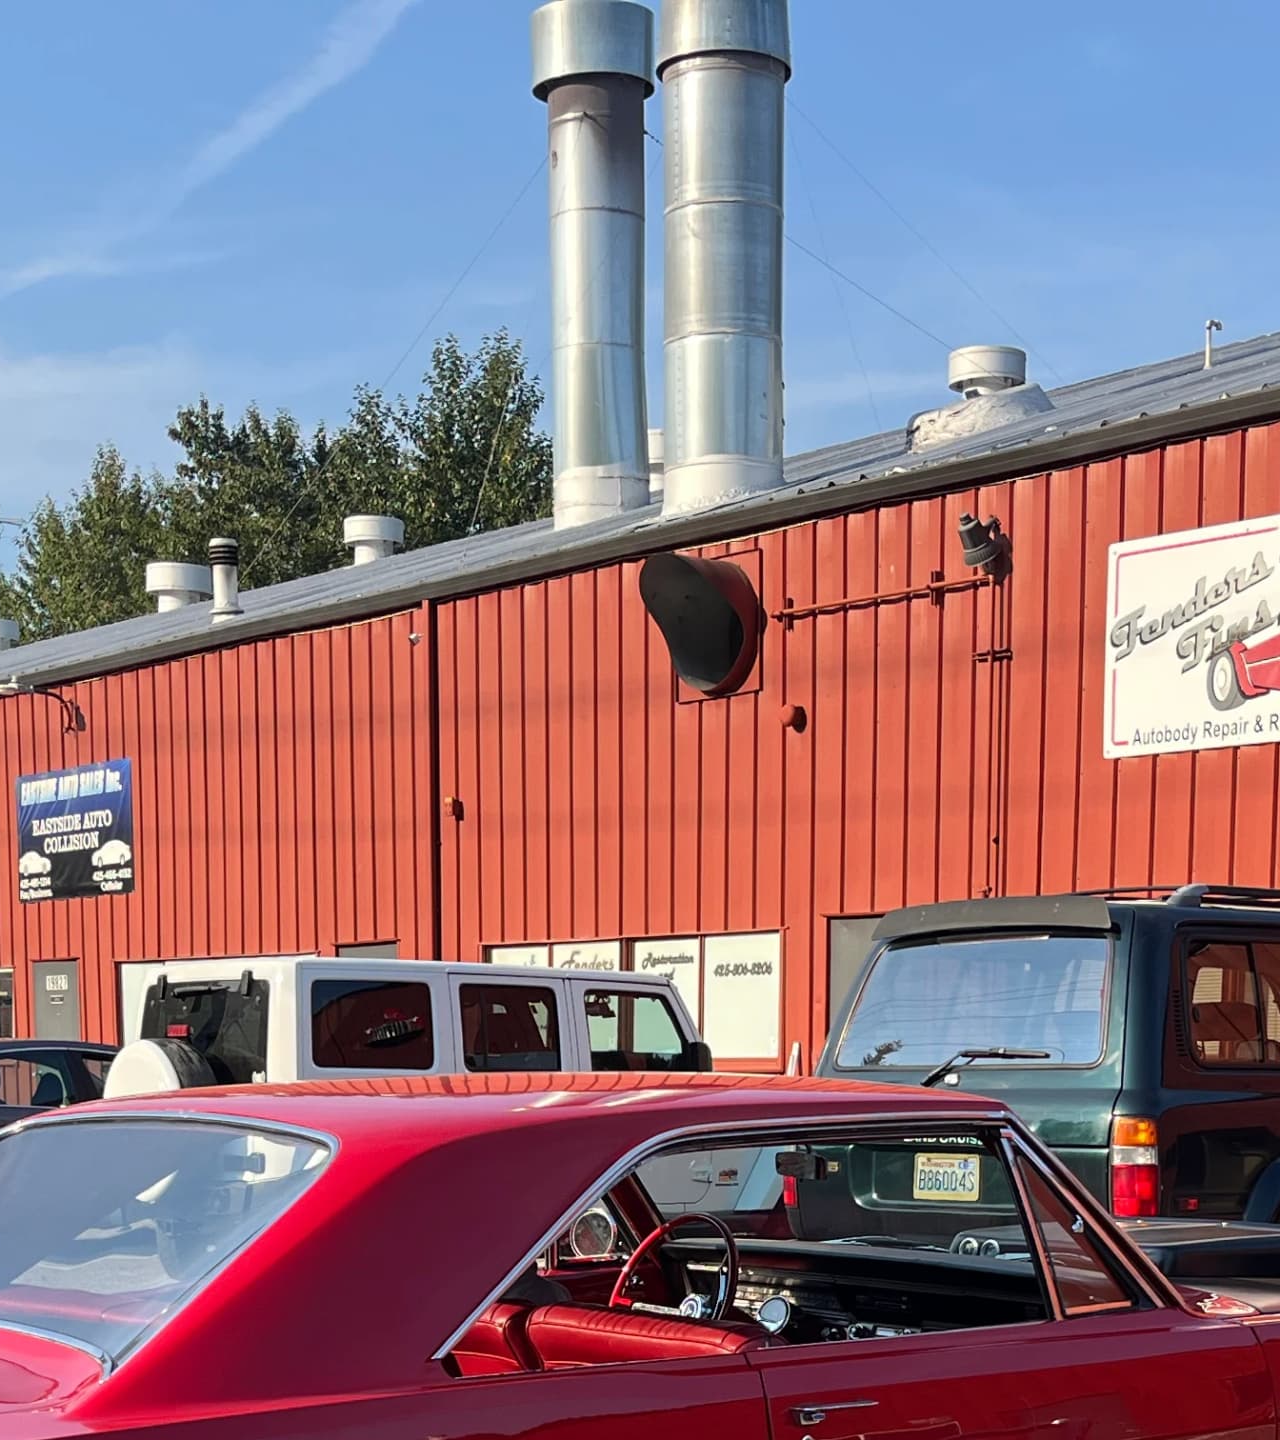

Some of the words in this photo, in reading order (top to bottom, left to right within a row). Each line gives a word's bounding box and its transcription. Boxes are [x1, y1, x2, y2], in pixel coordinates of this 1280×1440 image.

[1110, 551, 1275, 662] Fenders
[1132, 723, 1198, 747] Autobody
[1202, 718, 1250, 742] Repair
[1254, 718, 1264, 734] &
[31, 815, 82, 836] EASTSIDE
[83, 809, 112, 830] AUTO
[43, 831, 100, 854] COLLISION
[561, 950, 615, 970] Fenders
